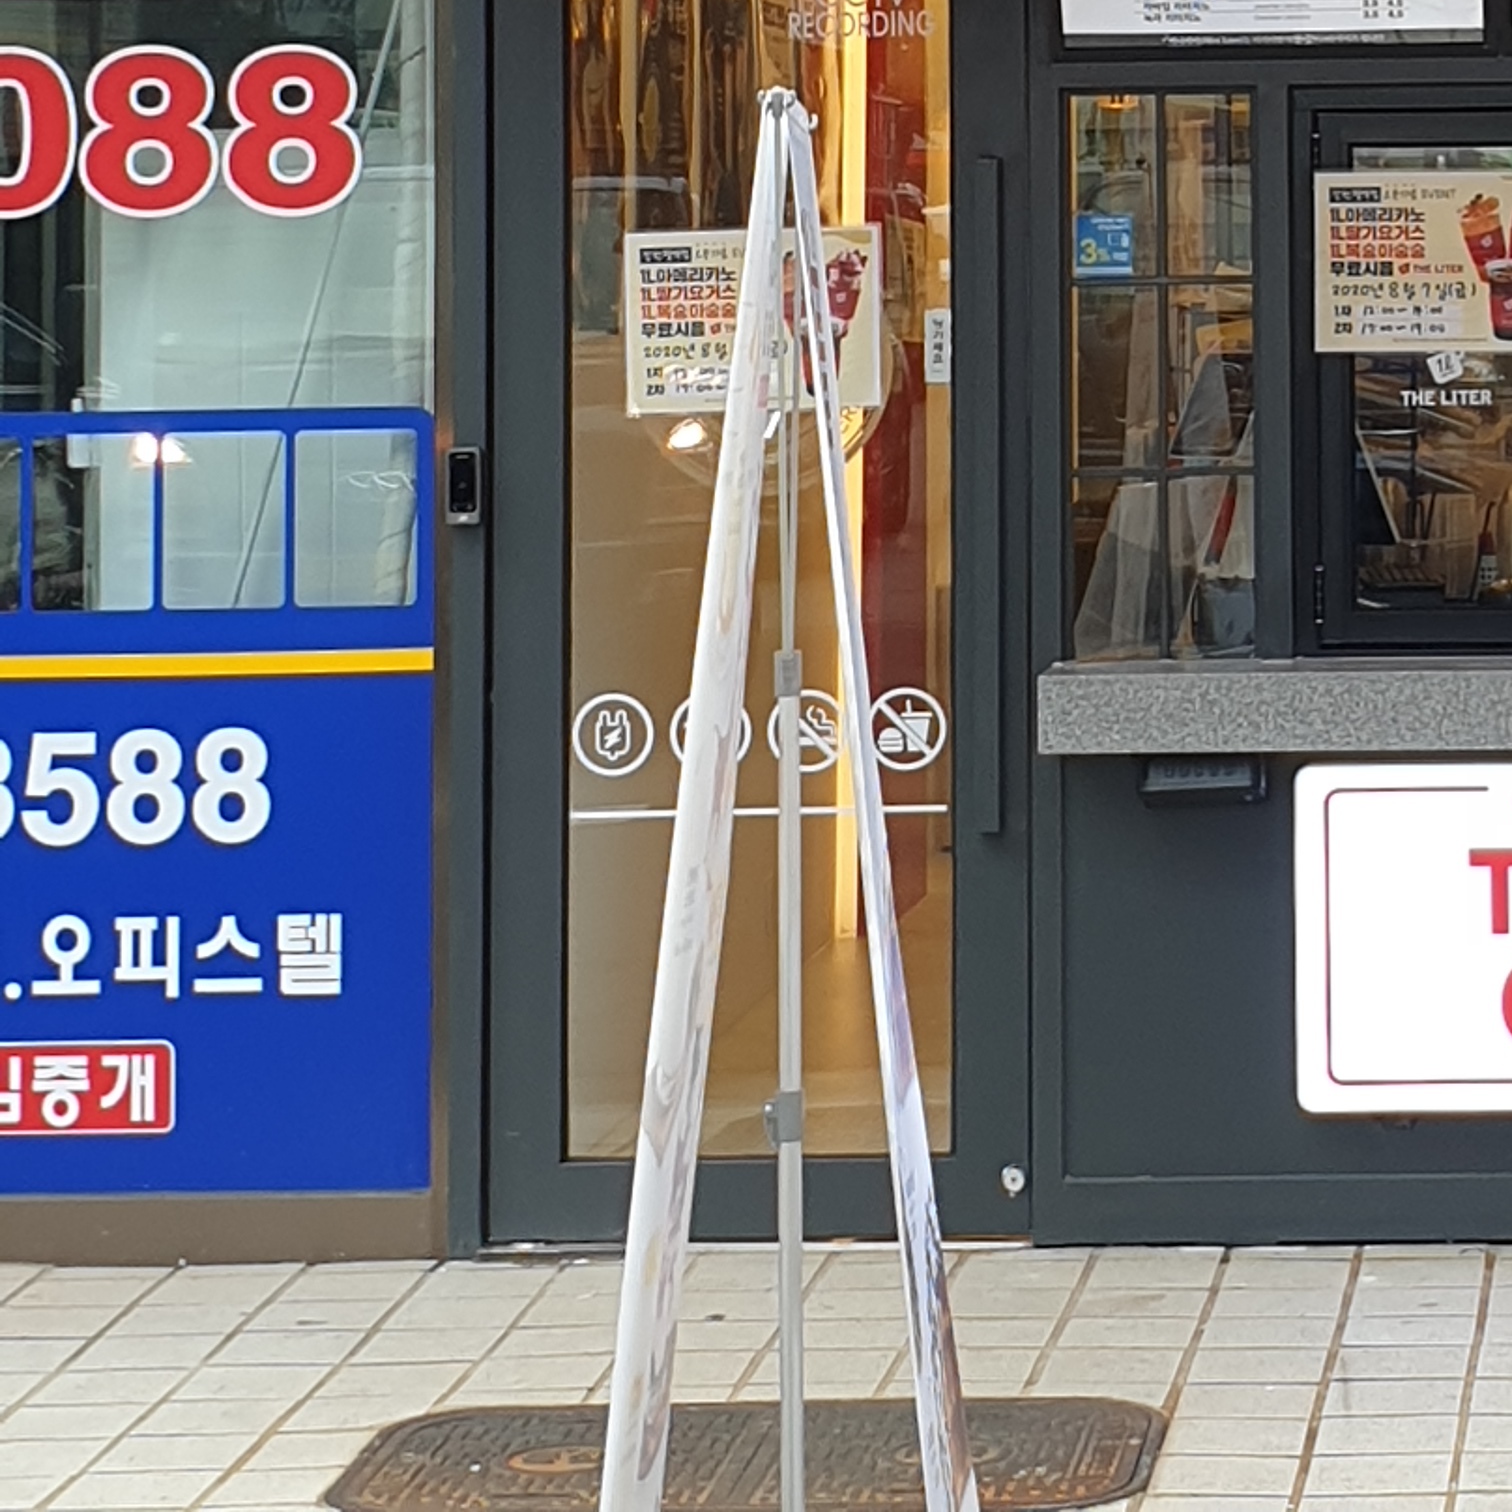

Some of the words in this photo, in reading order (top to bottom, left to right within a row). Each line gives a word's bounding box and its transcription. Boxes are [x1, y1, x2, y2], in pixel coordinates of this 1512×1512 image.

[787, 9, 936, 40] RECORDING
[1400, 389, 1437, 407] THE
[1440, 389, 1493, 407] LITER
[0, 726, 272, 847] 588
